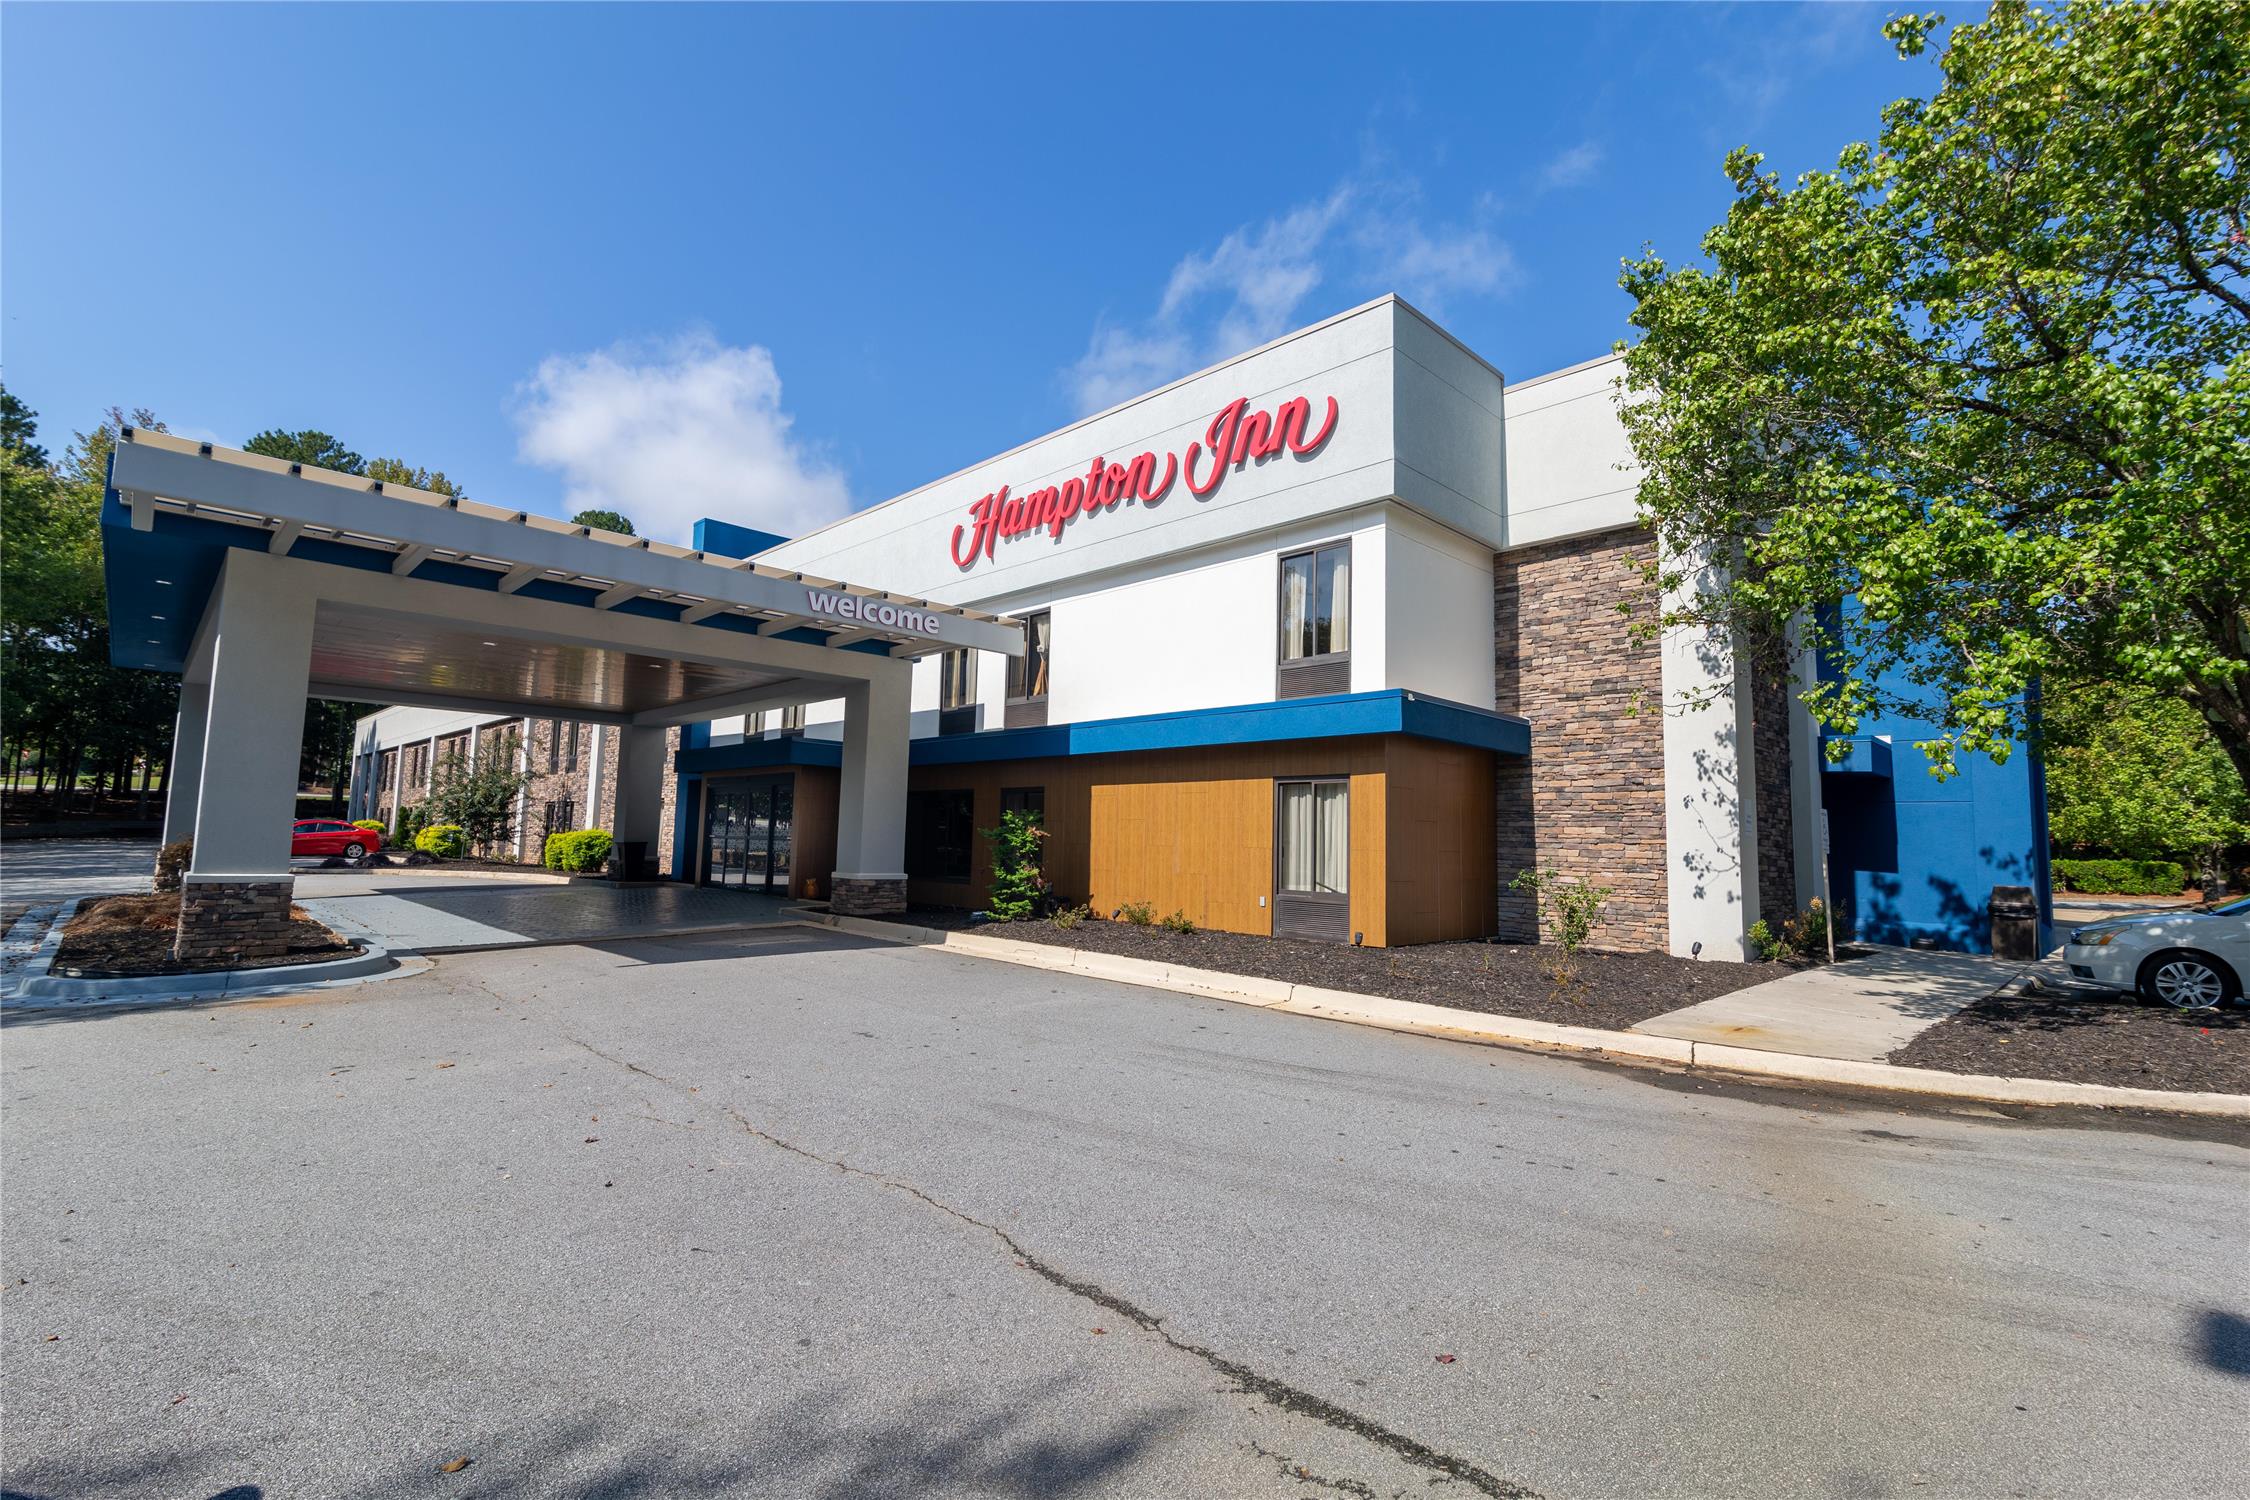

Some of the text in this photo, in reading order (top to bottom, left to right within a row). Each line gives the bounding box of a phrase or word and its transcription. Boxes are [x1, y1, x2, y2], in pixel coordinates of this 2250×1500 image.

[951, 395, 1338, 567] Hampton Inn
[807, 590, 940, 634] welcome
